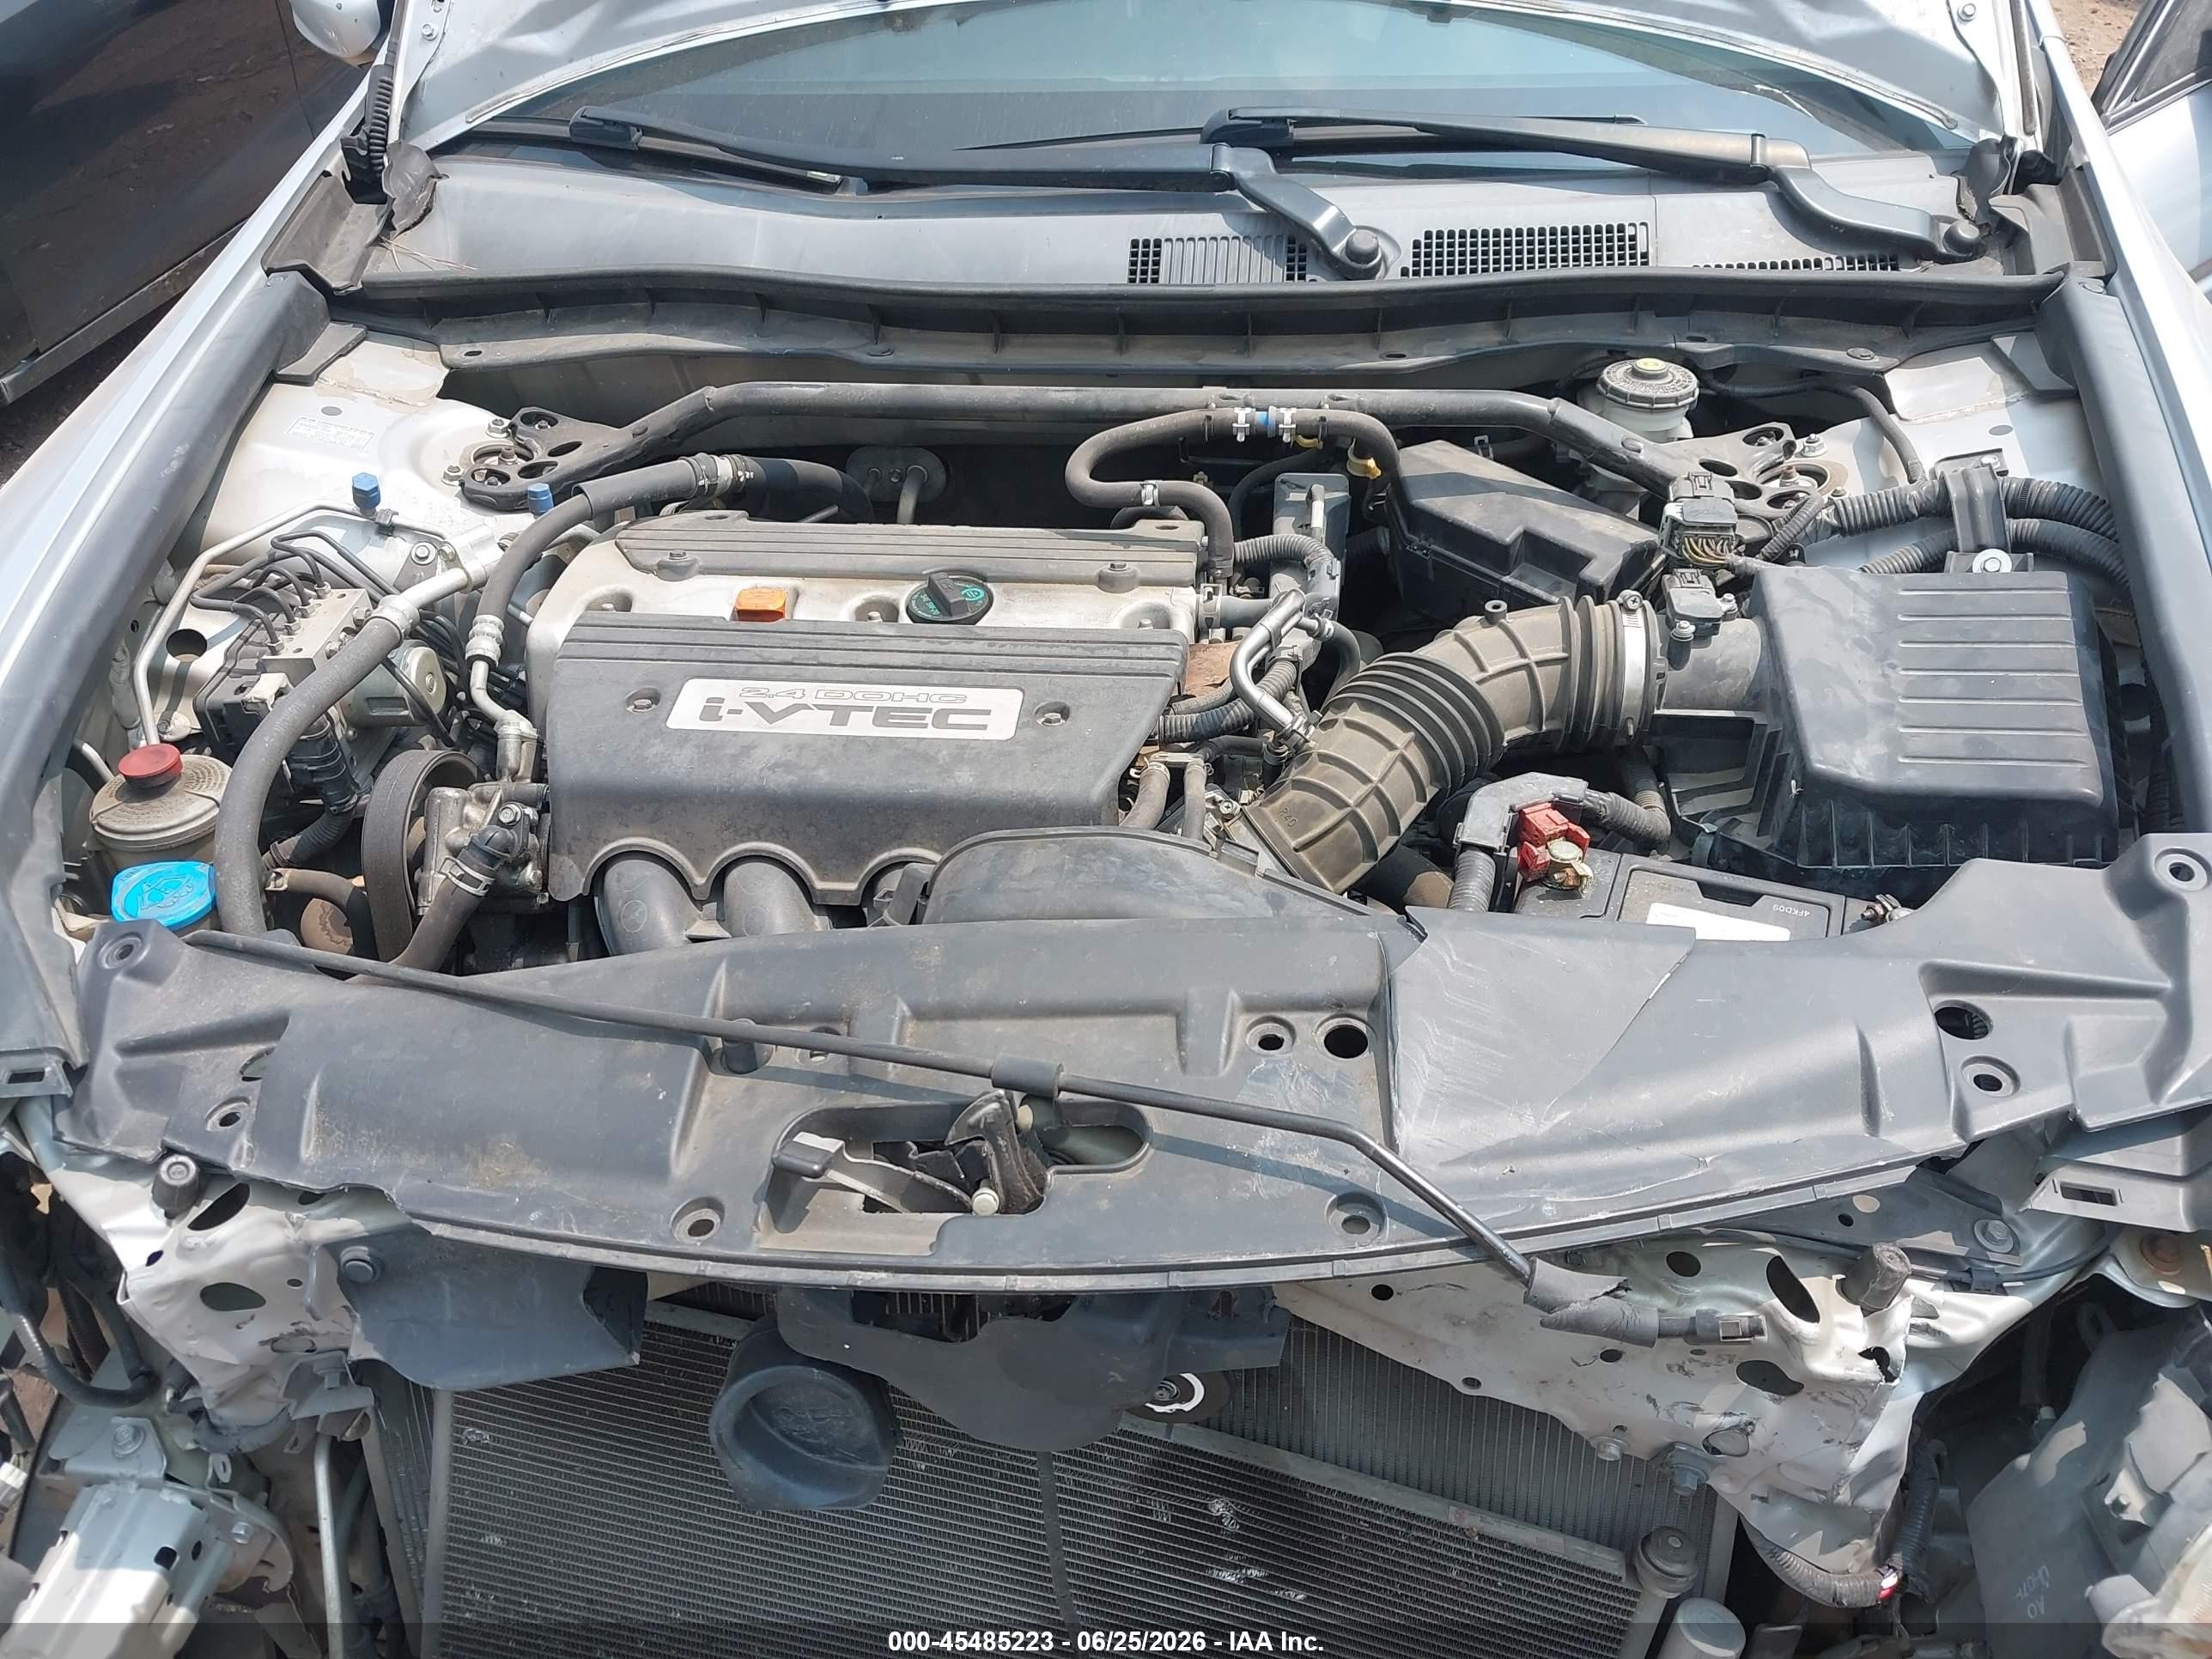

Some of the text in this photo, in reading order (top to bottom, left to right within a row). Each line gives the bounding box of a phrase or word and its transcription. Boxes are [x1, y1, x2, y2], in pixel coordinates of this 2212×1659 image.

[739, 687, 967, 703] 2.4 DOHC
[699, 696, 992, 731] i-VTEC
